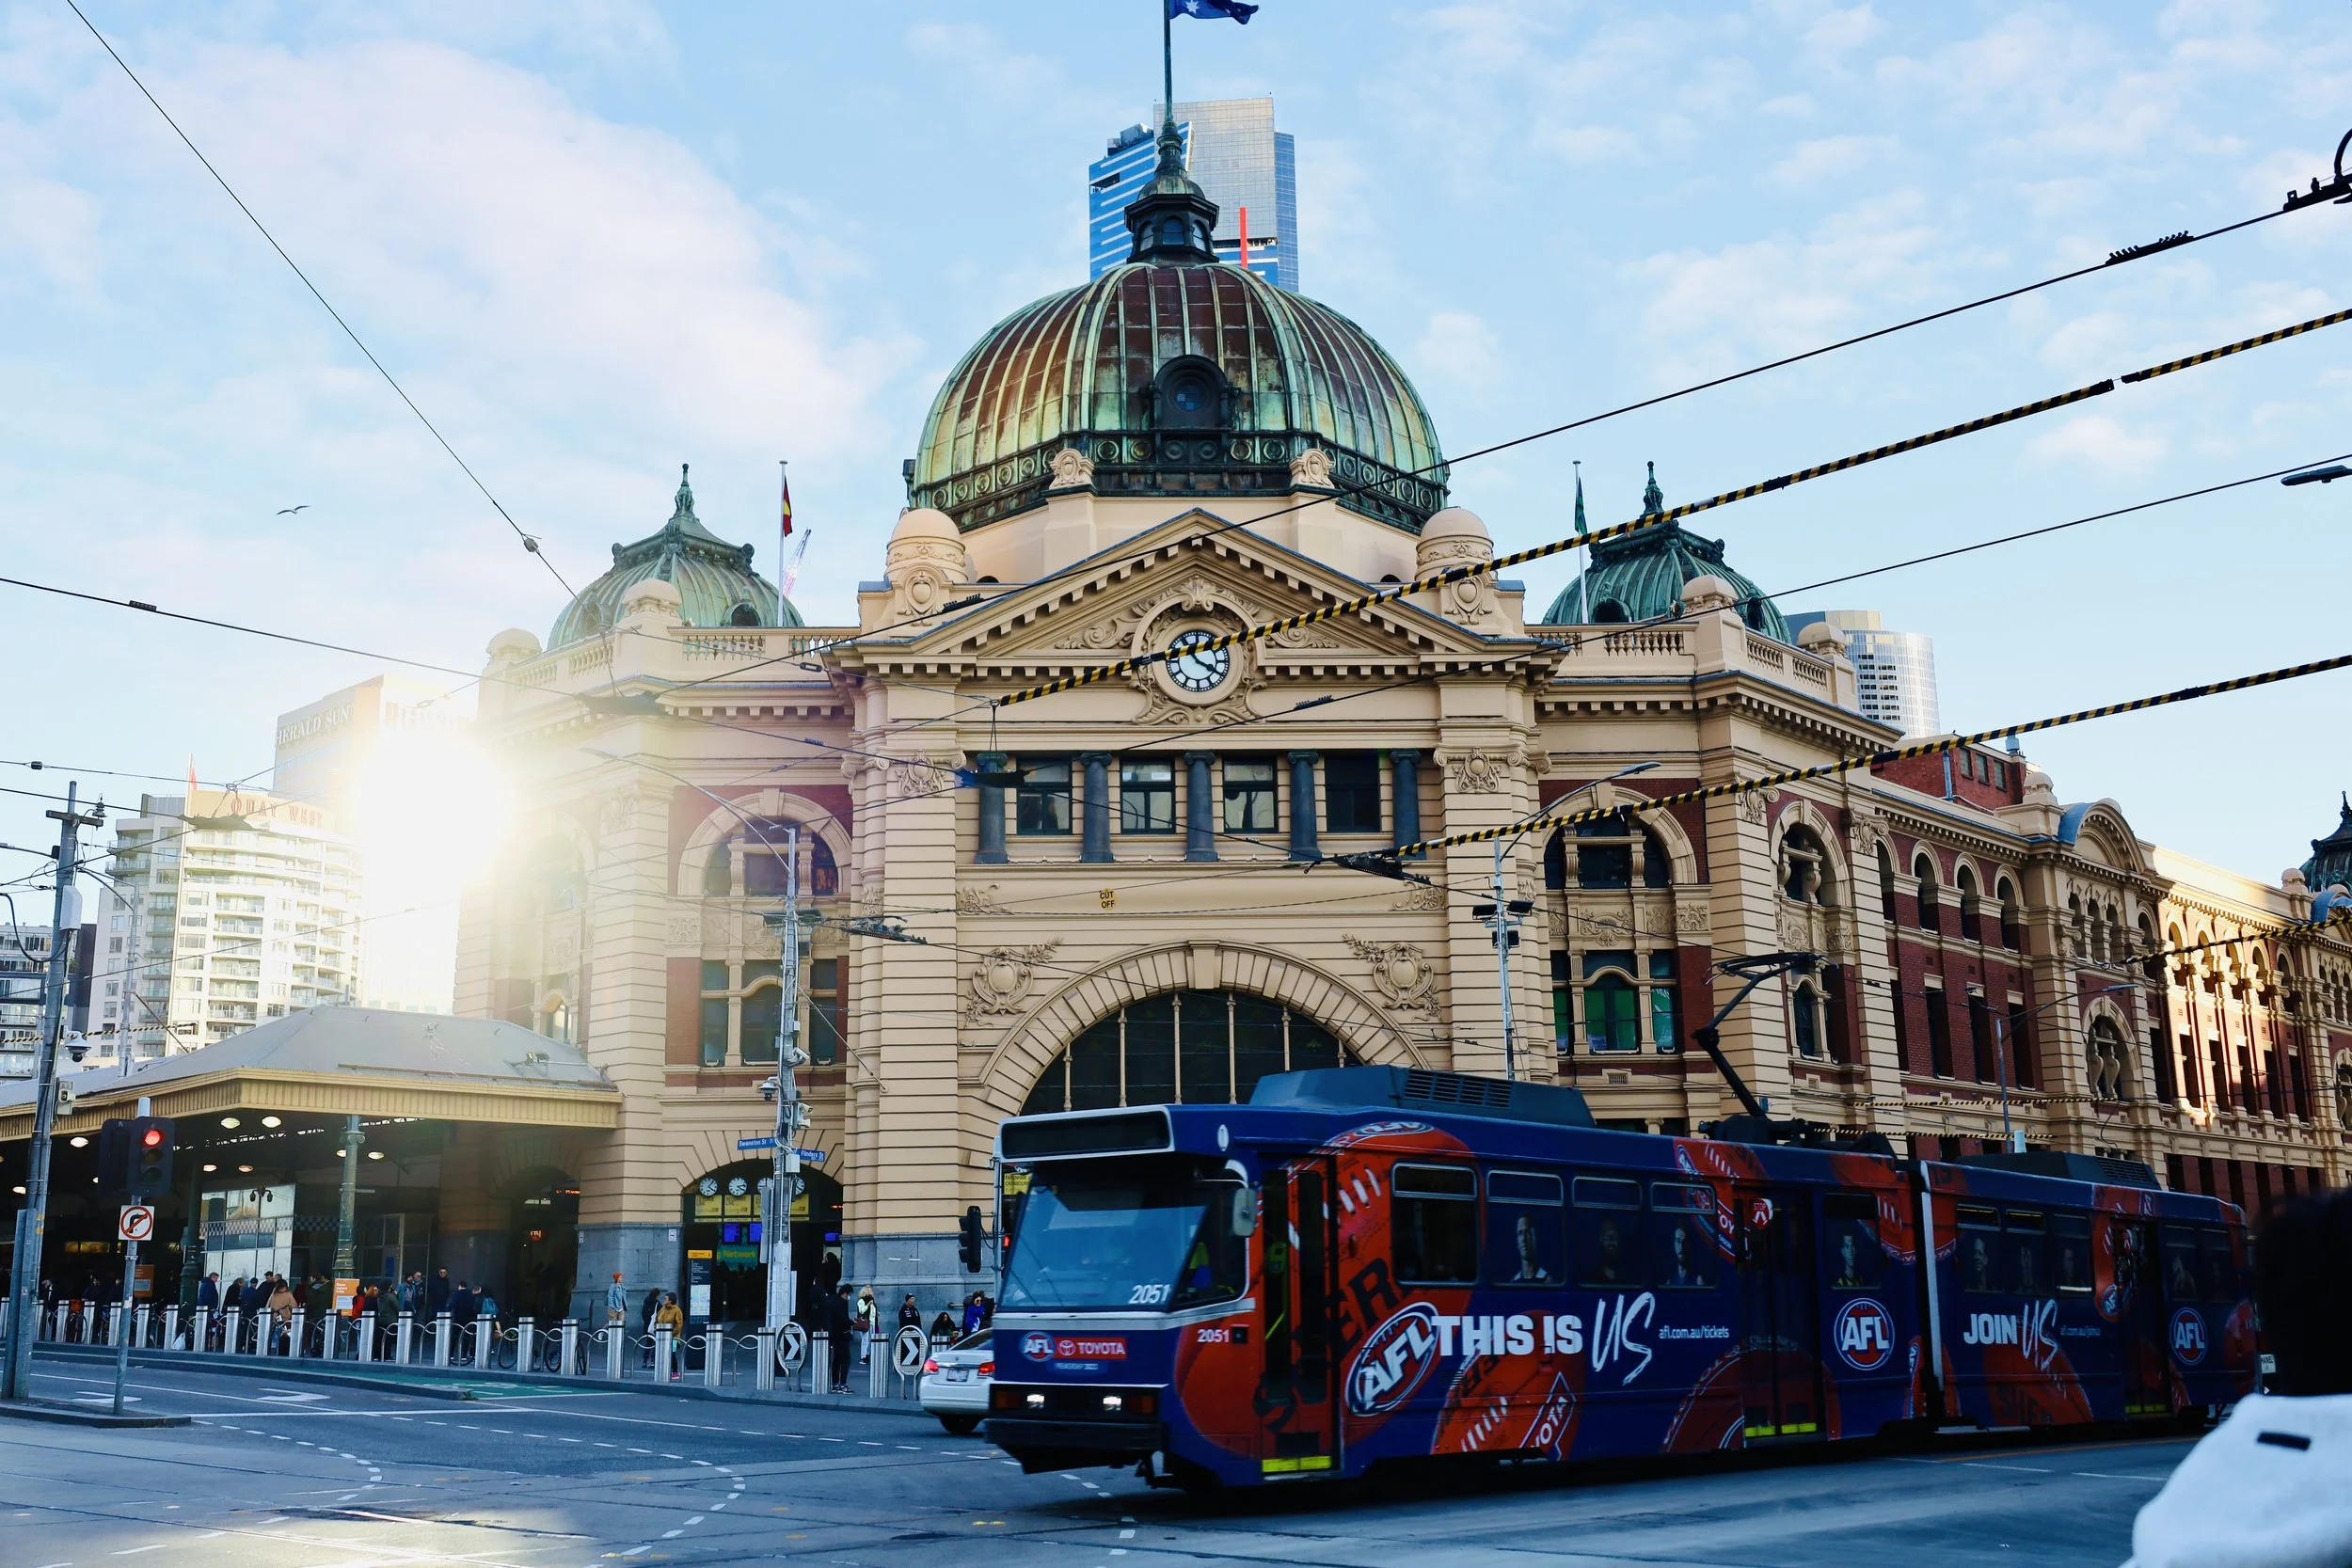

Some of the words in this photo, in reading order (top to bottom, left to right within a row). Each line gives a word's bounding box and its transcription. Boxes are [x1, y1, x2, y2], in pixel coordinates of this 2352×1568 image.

[276, 715, 322, 745] HERALD
[325, 704, 352, 730] SUN
[231, 797, 277, 817] QUAY
[289, 804, 323, 829] WEST
[1100, 891, 1114, 899] CUT
[1101, 900, 1114, 909] OFF
[739, 1139, 760, 1148] Swanston
[801, 1149, 818, 1158] Flinders
[1128, 1284, 1170, 1305] 2051
[1197, 1329, 1230, 1343] 2051
[1431, 1315, 1534, 1356] THIS
[1543, 1315, 1583, 1354] IS
[1592, 1292, 1656, 1386] US
[1659, 1325, 1729, 1339] afl.com.au/tickets
[1841, 1316, 1890, 1351] AFL
[1963, 1313, 2018, 1345] JOIN
[2022, 1298, 2058, 1371] US
[2175, 1322, 2205, 1349] AFL
[1024, 1338, 1054, 1354] AFL
[1077, 1342, 1126, 1354] TOYOTA
[1359, 1319, 1435, 1411] AFL
